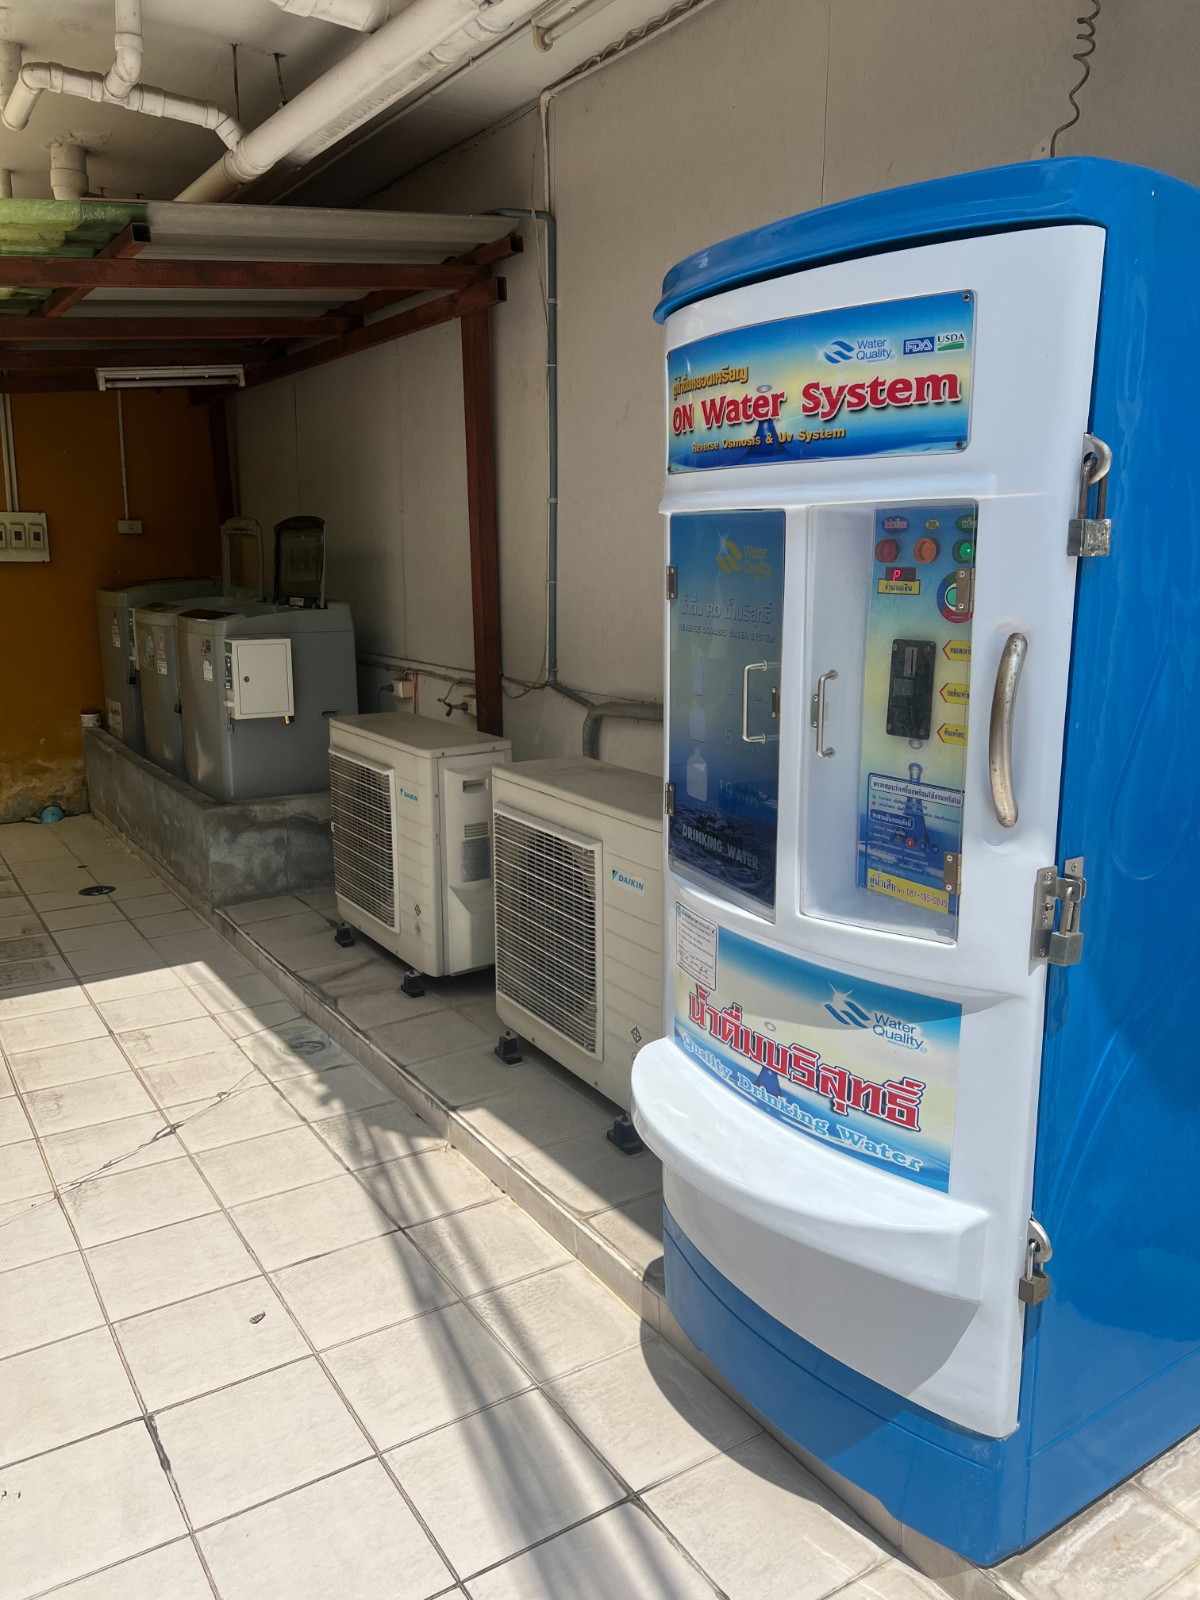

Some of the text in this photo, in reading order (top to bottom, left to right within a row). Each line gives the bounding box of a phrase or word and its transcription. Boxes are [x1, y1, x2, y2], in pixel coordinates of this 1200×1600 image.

[857, 339, 887, 350] Water
[905, 339, 933, 353] FDA
[937, 333, 965, 343] USDA
[856, 349, 892, 361] Quality
[672, 372, 961, 434] ON Water System
[692, 440, 719, 453] Reverse
[722, 434, 761, 448] Osmosis
[765, 433, 773, 444] &
[797, 427, 846, 442] System
[681, 823, 759, 871] DRINKING WATER
[618, 874, 645, 891] DAIKIN
[874, 1012, 917, 1034] Water
[872, 1024, 924, 1049] Quality
[689, 983, 927, 1132] น้ำดื่มบริสุทธิ์
[681, 1033, 924, 1173] Quality Drinking Water
